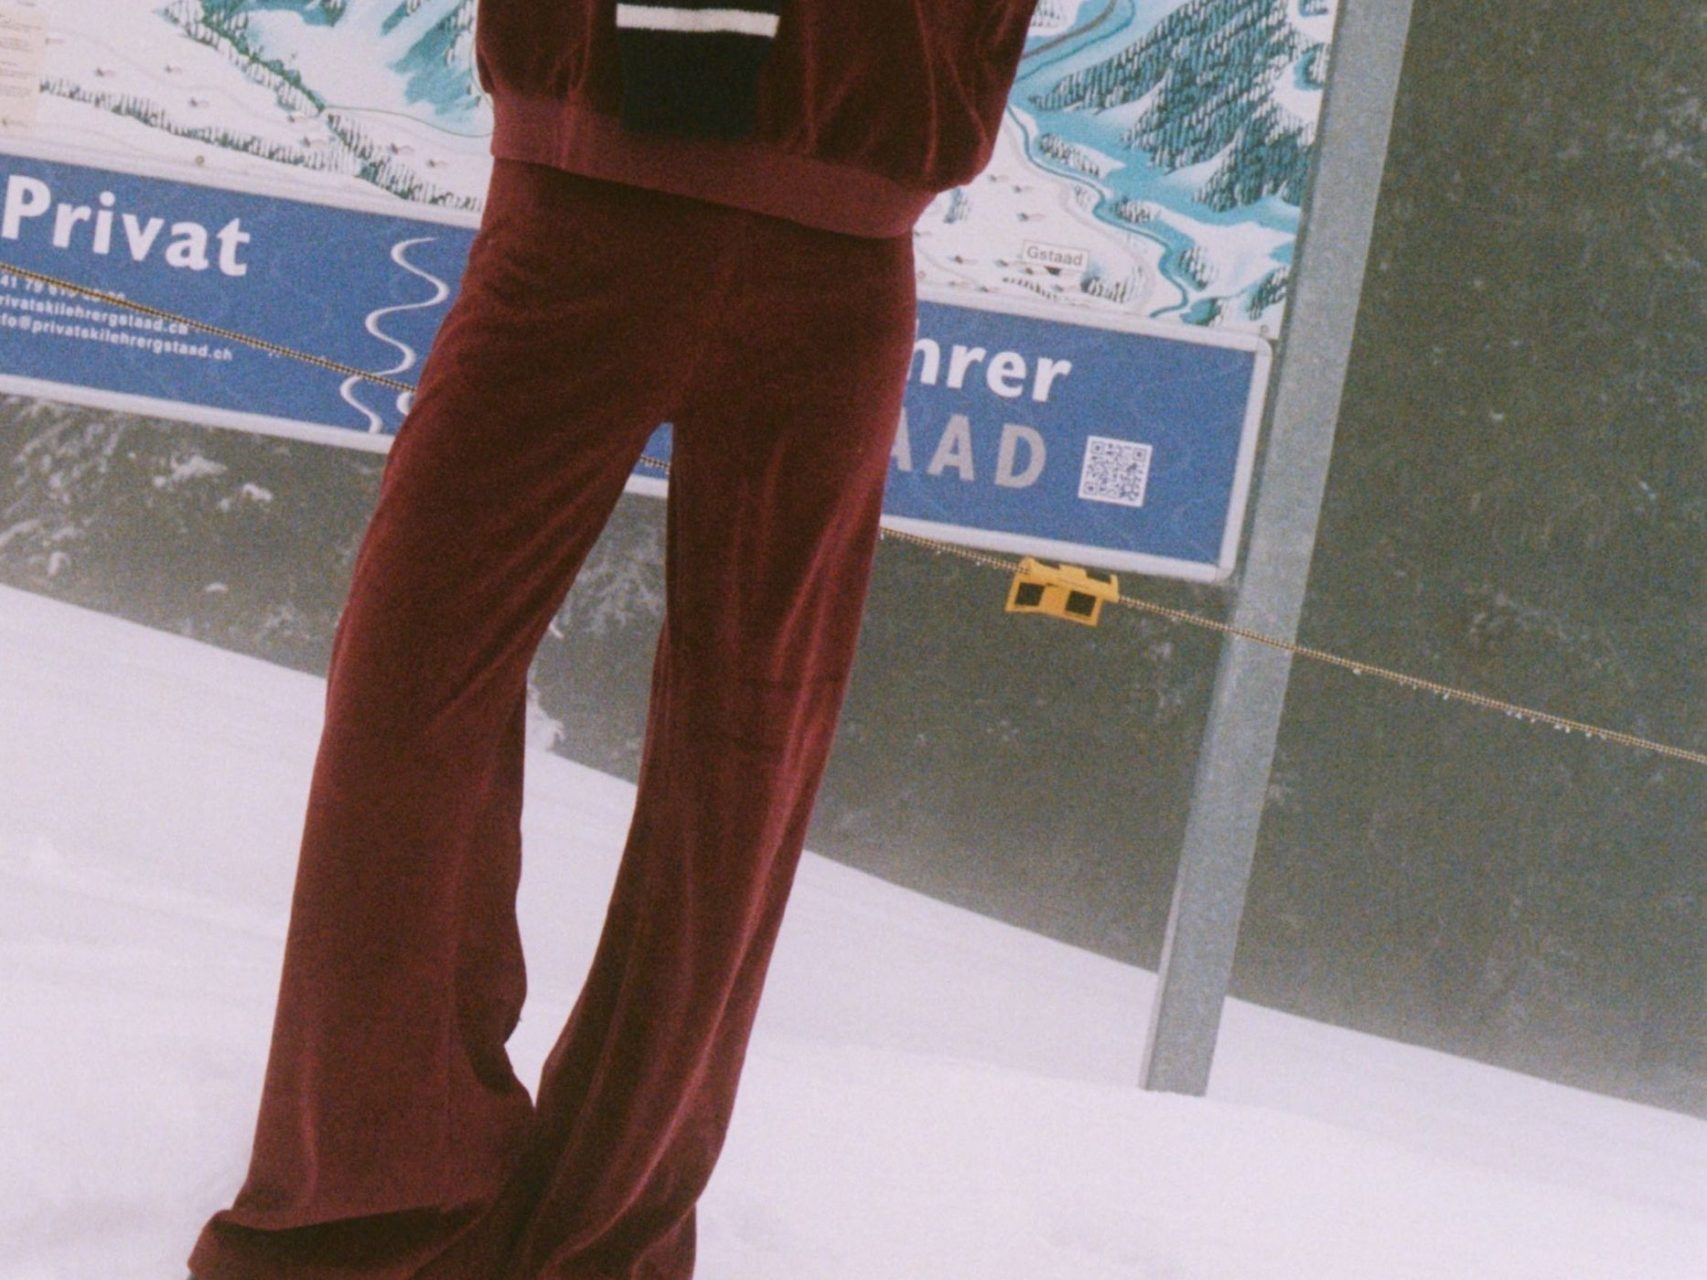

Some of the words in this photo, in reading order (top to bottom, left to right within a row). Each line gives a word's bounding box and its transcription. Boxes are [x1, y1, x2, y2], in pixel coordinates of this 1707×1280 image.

[2, 175, 250, 276] Privat
[1026, 245, 1084, 266] Gstaad
[0, 312, 232, 360] fo@privatskilehrergstaad.ch
